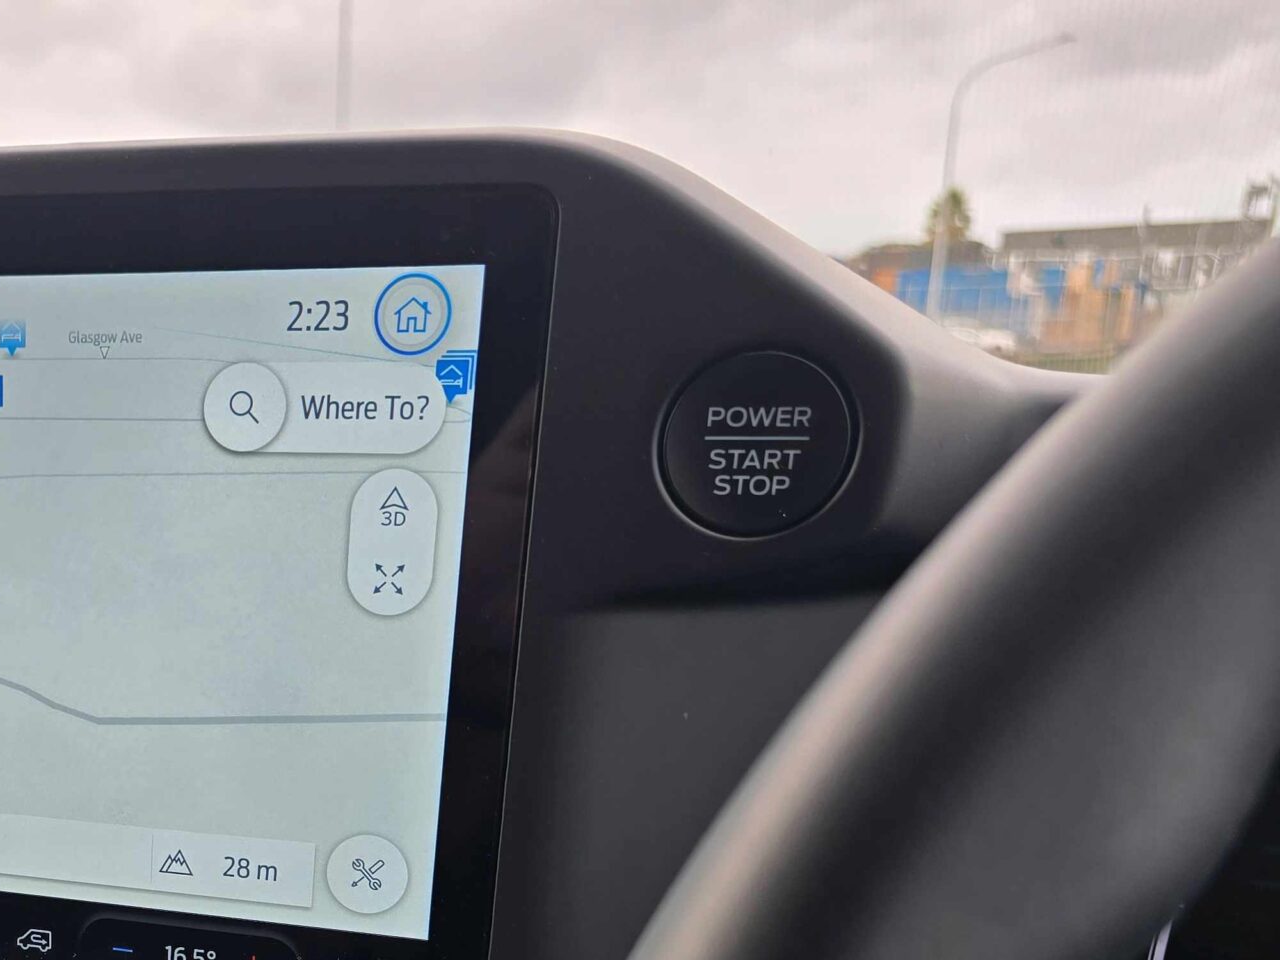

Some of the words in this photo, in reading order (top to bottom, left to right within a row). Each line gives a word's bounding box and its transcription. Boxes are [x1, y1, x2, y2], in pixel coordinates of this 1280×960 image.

[285, 299, 351, 332] 2:23
[67, 330, 117, 346] Glasgow
[119, 330, 143, 344] Ave
[300, 395, 378, 422] Where
[384, 396, 431, 422] To?
[706, 406, 812, 428] POWER
[708, 449, 801, 470] START
[713, 474, 790, 496] STOP
[380, 511, 406, 528] 3D
[223, 857, 251, 879] 28
[255, 865, 278, 881] m
